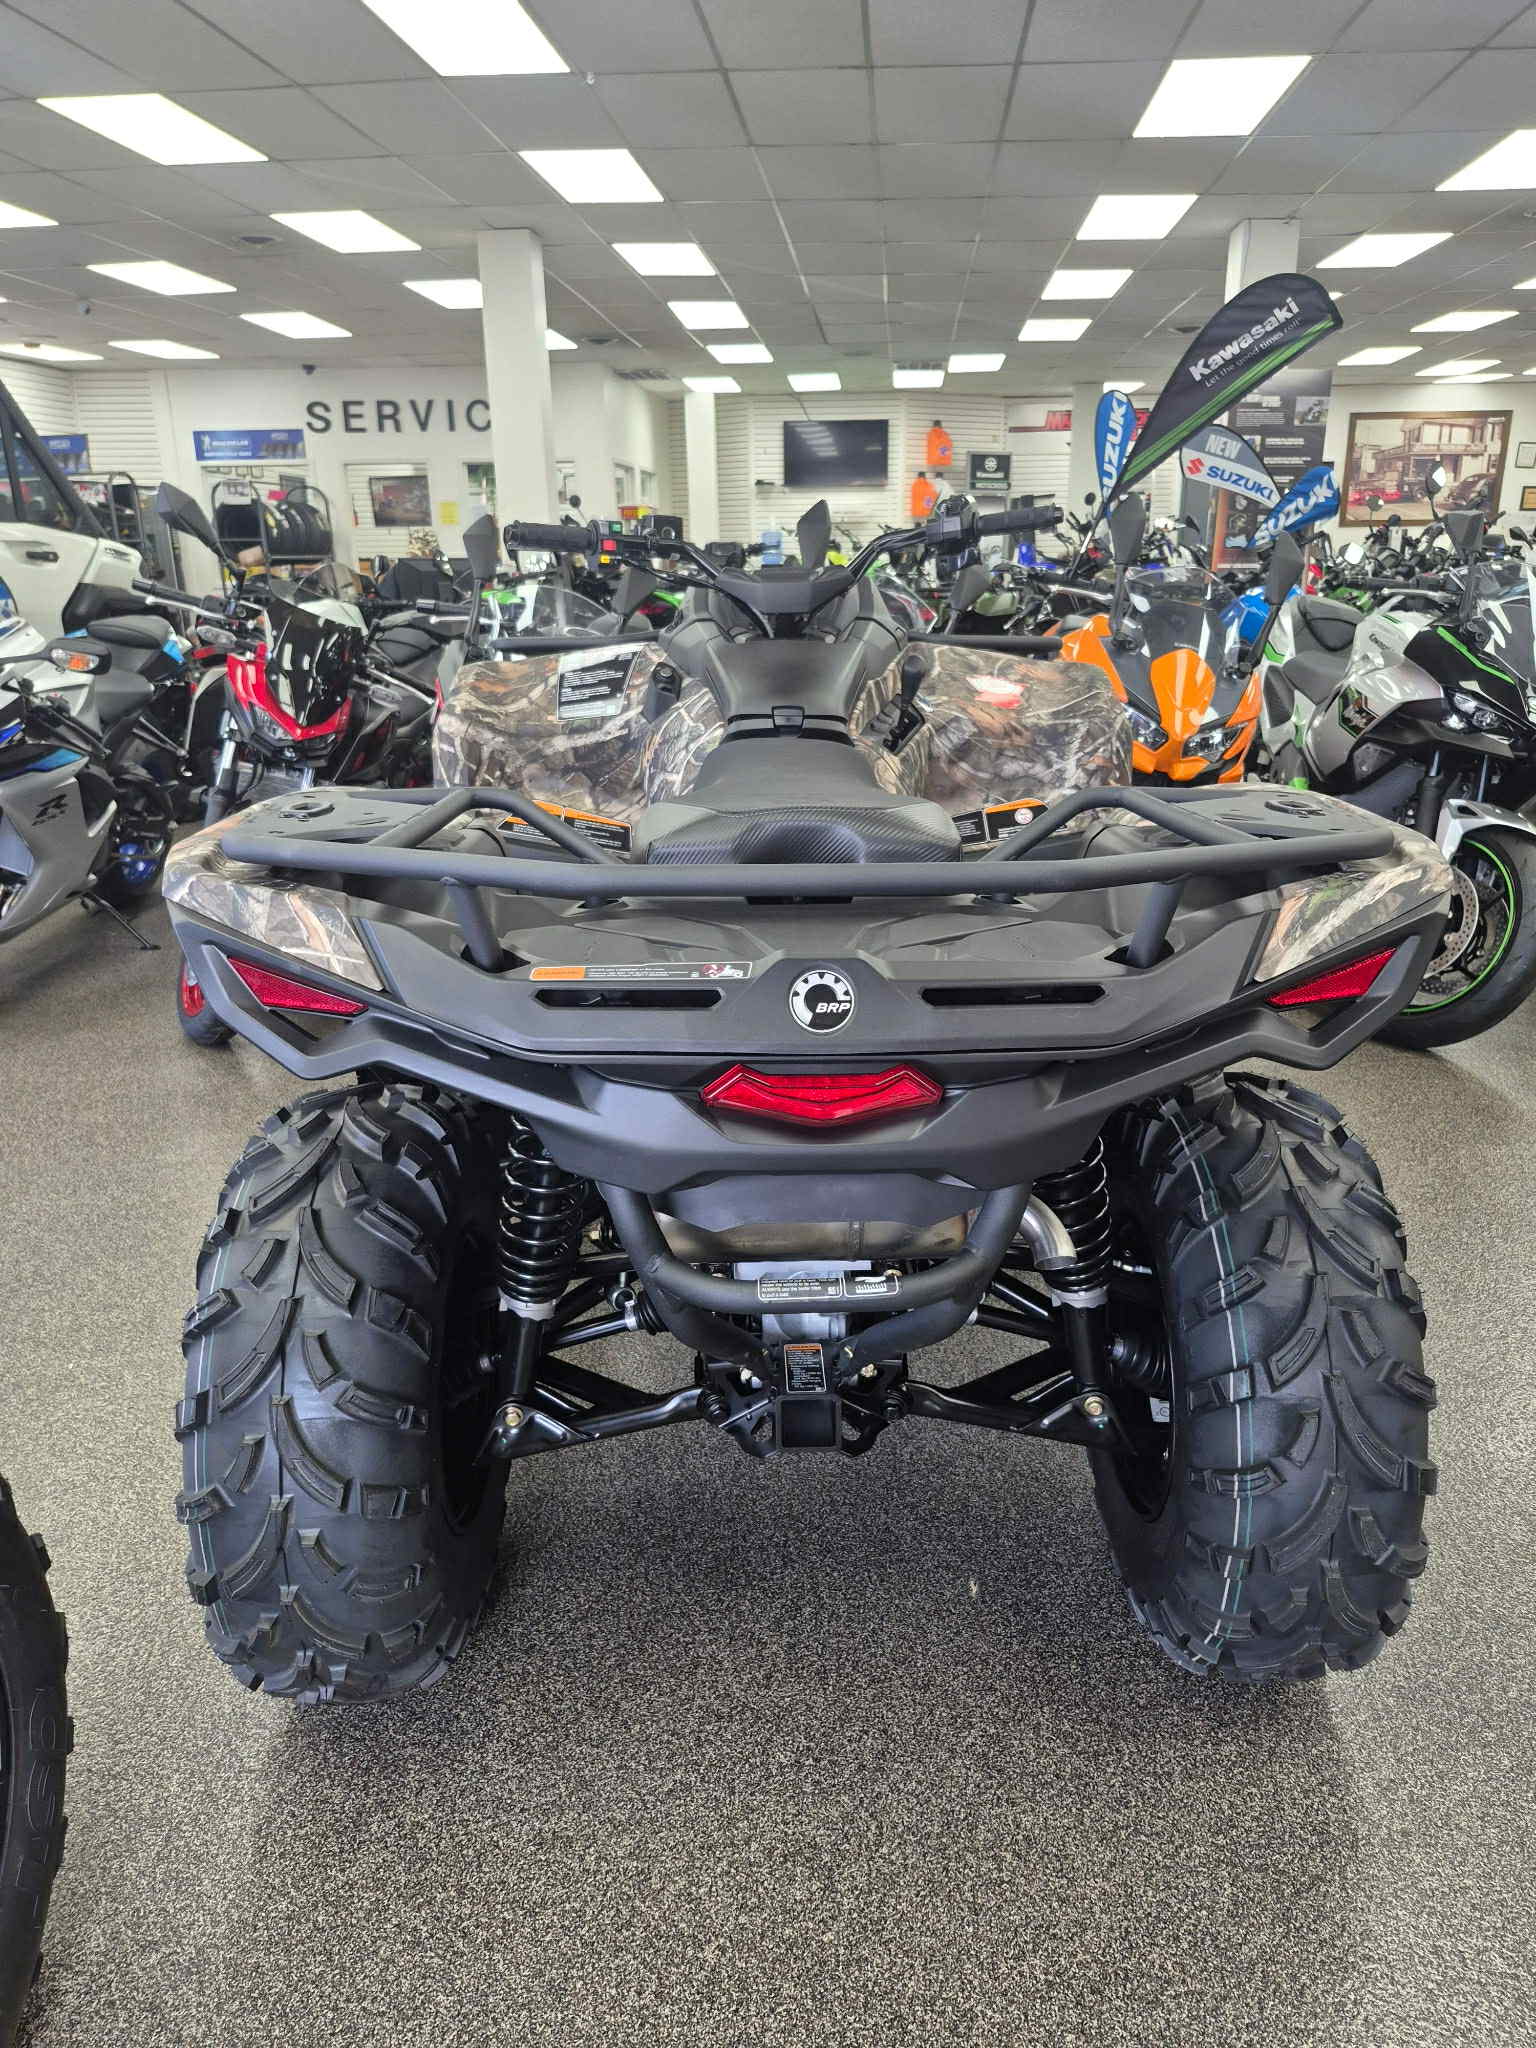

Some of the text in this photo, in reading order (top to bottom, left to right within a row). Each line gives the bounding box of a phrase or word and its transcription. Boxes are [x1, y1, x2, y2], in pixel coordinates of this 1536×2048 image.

[1189, 297, 1300, 382] Kawasaki
[1259, 331, 1284, 351] times
[1204, 434, 1242, 459] NEW
[1206, 465, 1274, 500] SUZUKI
[815, 1002, 851, 1014] BRP
